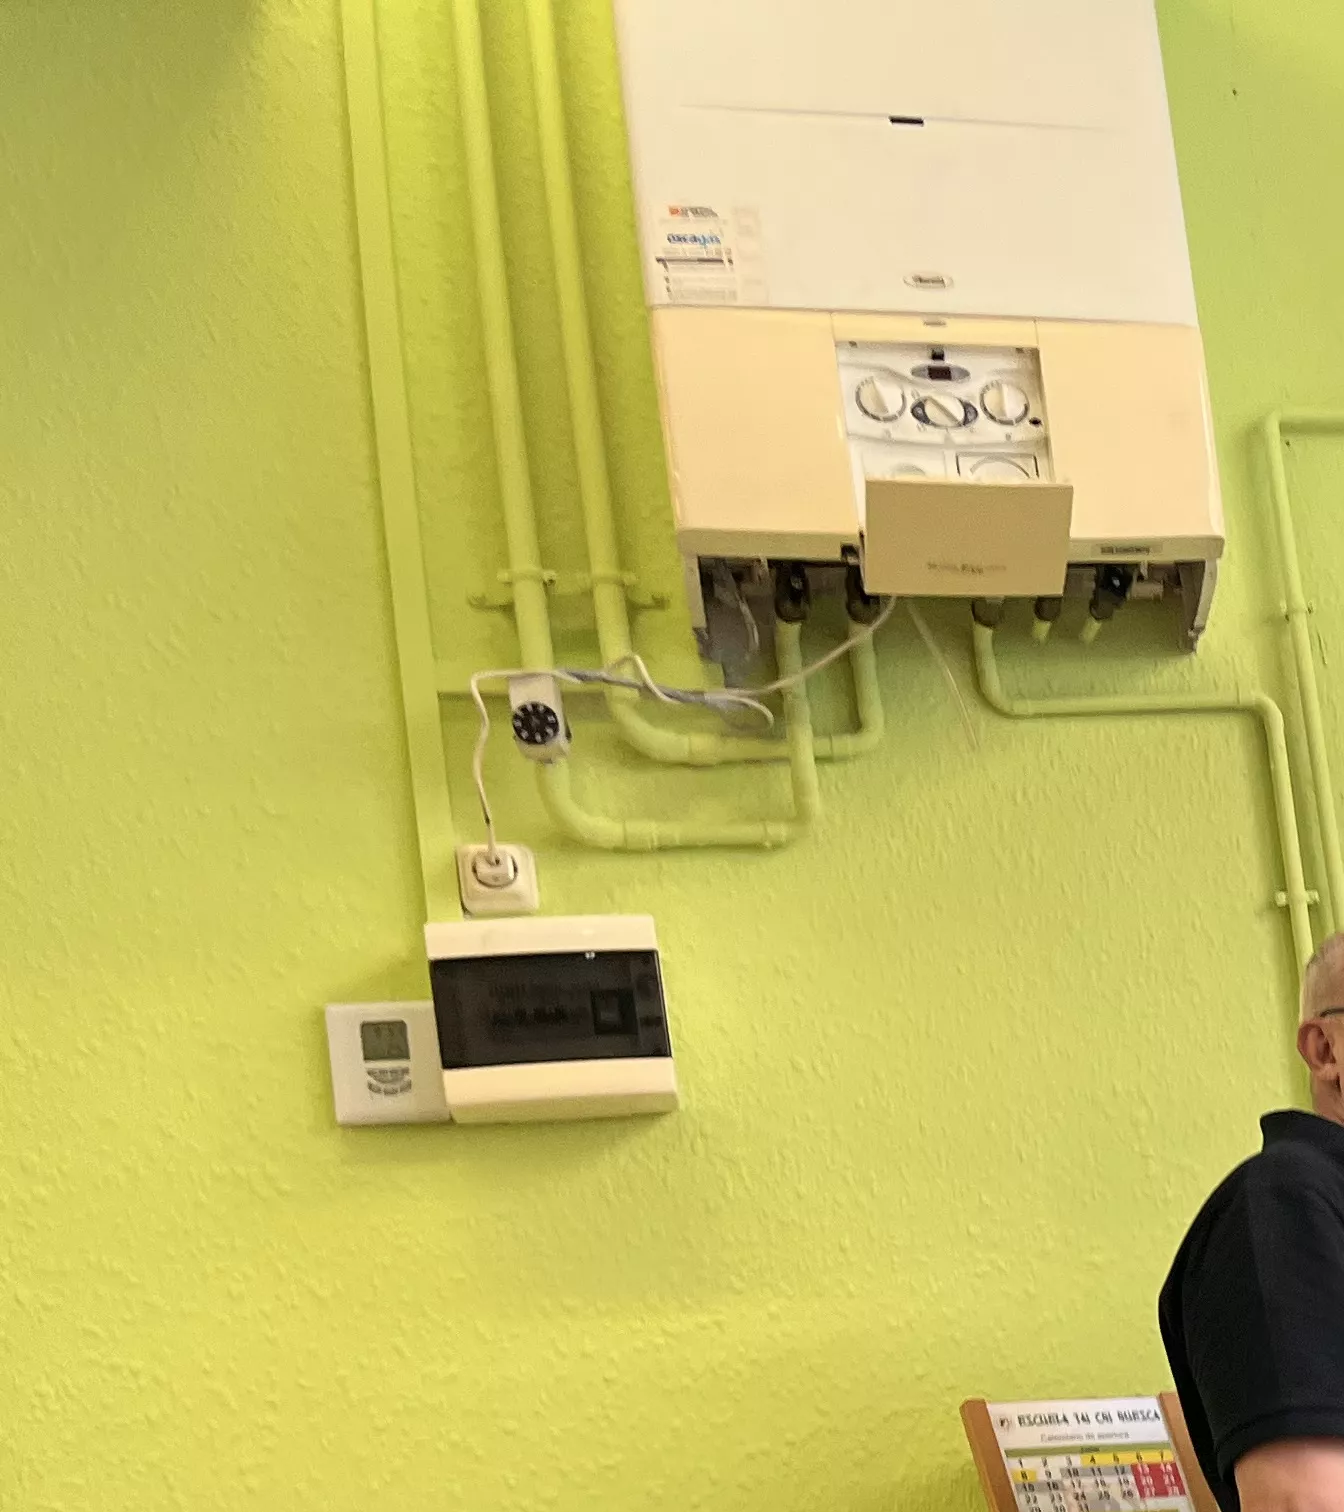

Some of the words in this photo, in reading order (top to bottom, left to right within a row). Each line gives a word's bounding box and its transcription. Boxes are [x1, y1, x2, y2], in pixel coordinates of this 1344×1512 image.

[1018, 1411, 1069, 1427] ESCUELA
[1073, 1411, 1091, 1426] TAI
[1095, 1410, 1113, 1425] CHI
[1117, 1408, 1161, 1423] HUESCA
